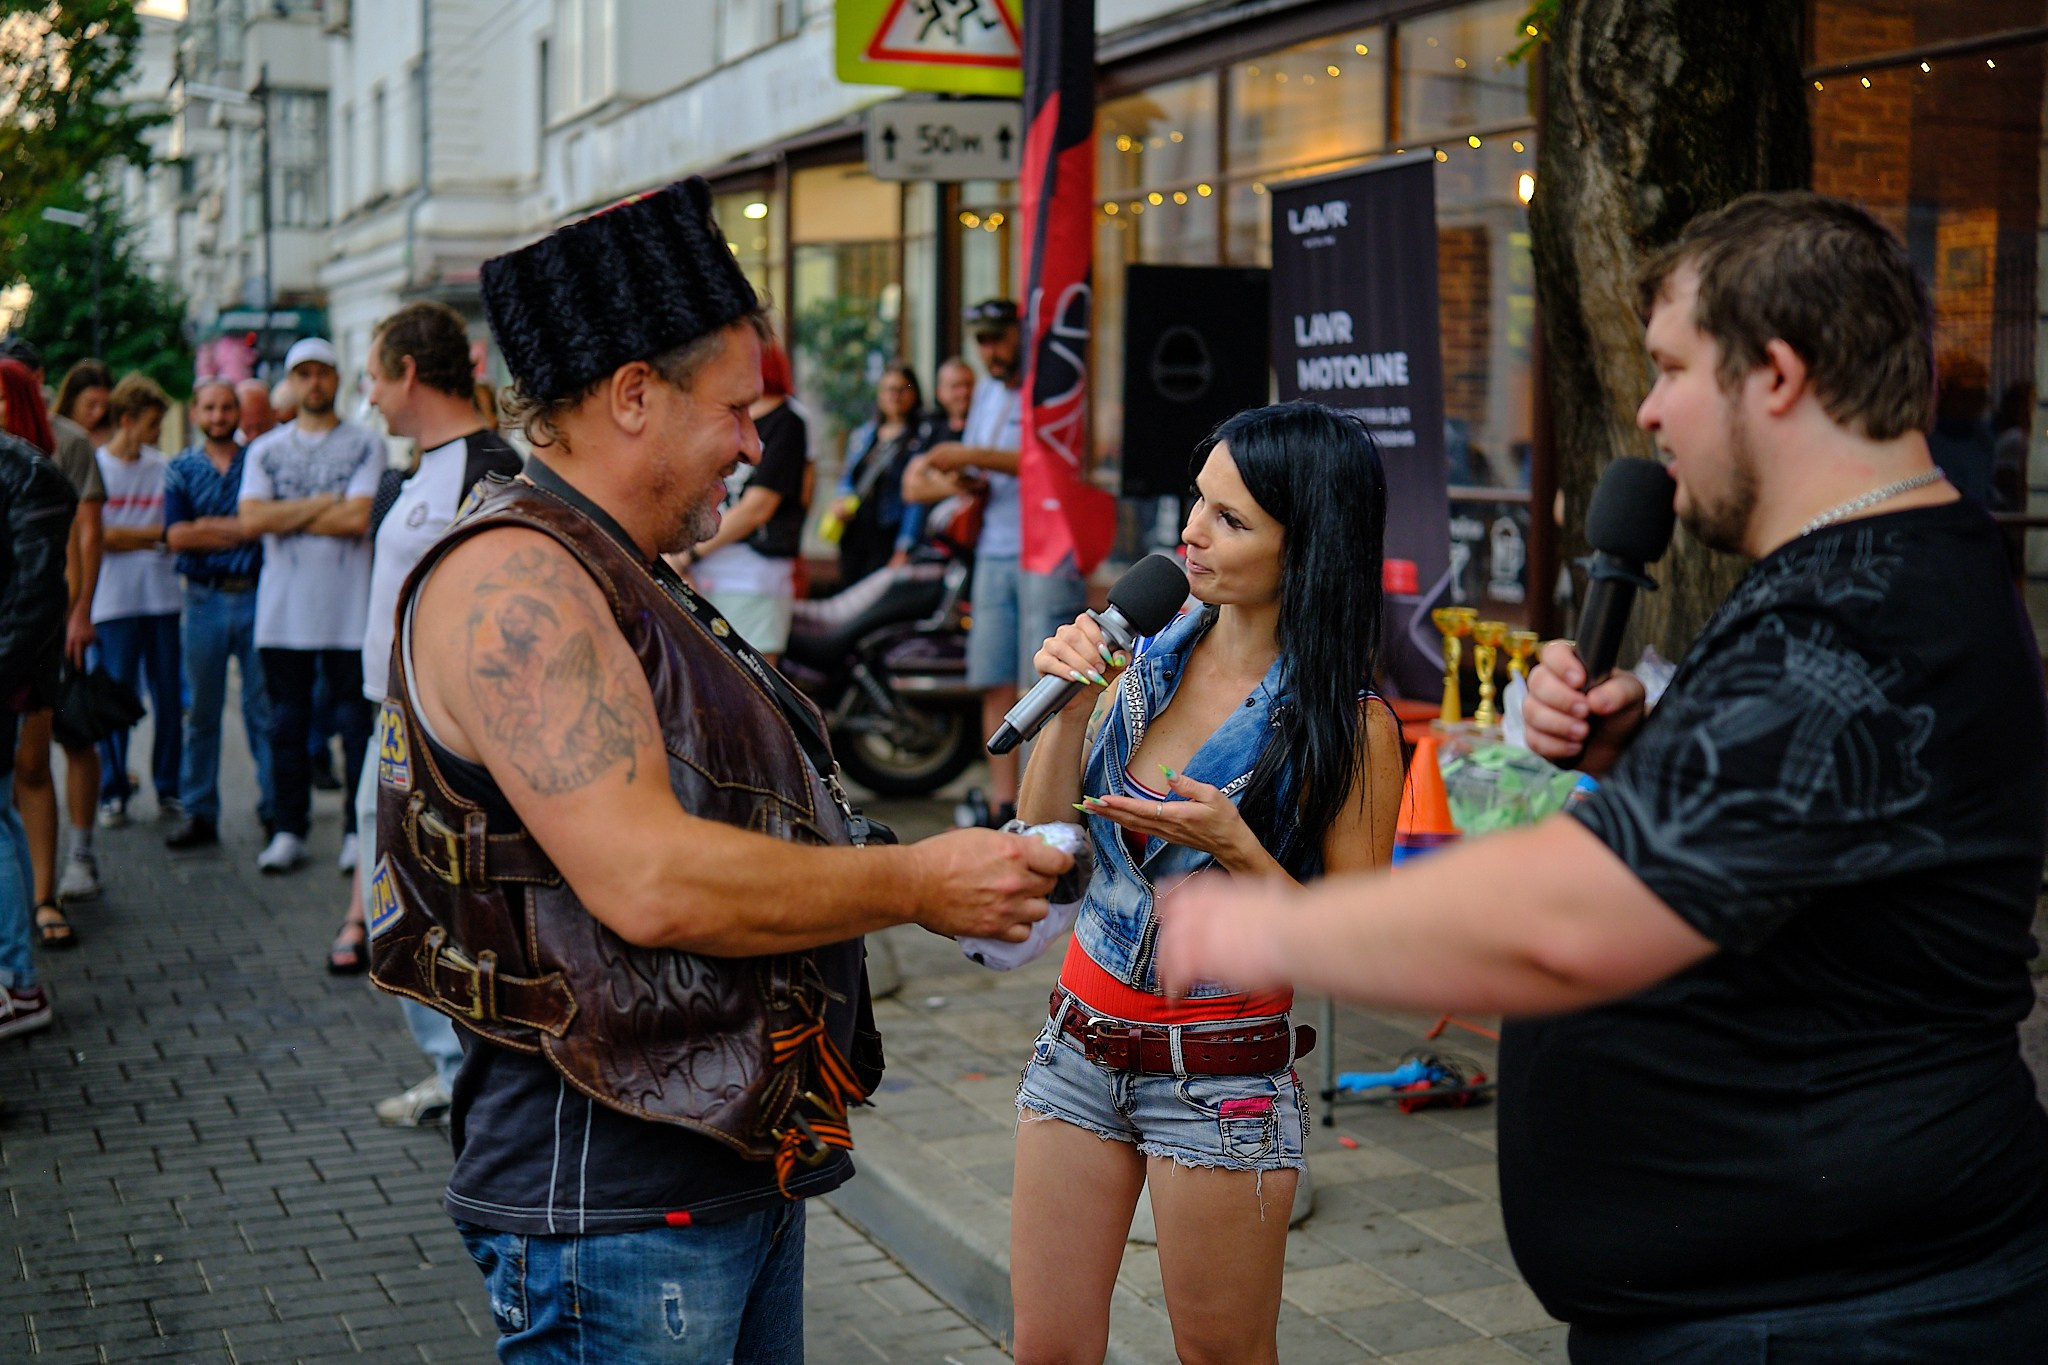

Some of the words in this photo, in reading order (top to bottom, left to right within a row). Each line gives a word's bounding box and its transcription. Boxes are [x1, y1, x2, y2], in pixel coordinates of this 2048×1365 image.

[1288, 200, 1349, 234] LAVR
[1294, 311, 1353, 347] LAVR
[1297, 352, 1410, 391] MOTOLINE
[381, 709, 407, 763] 23
